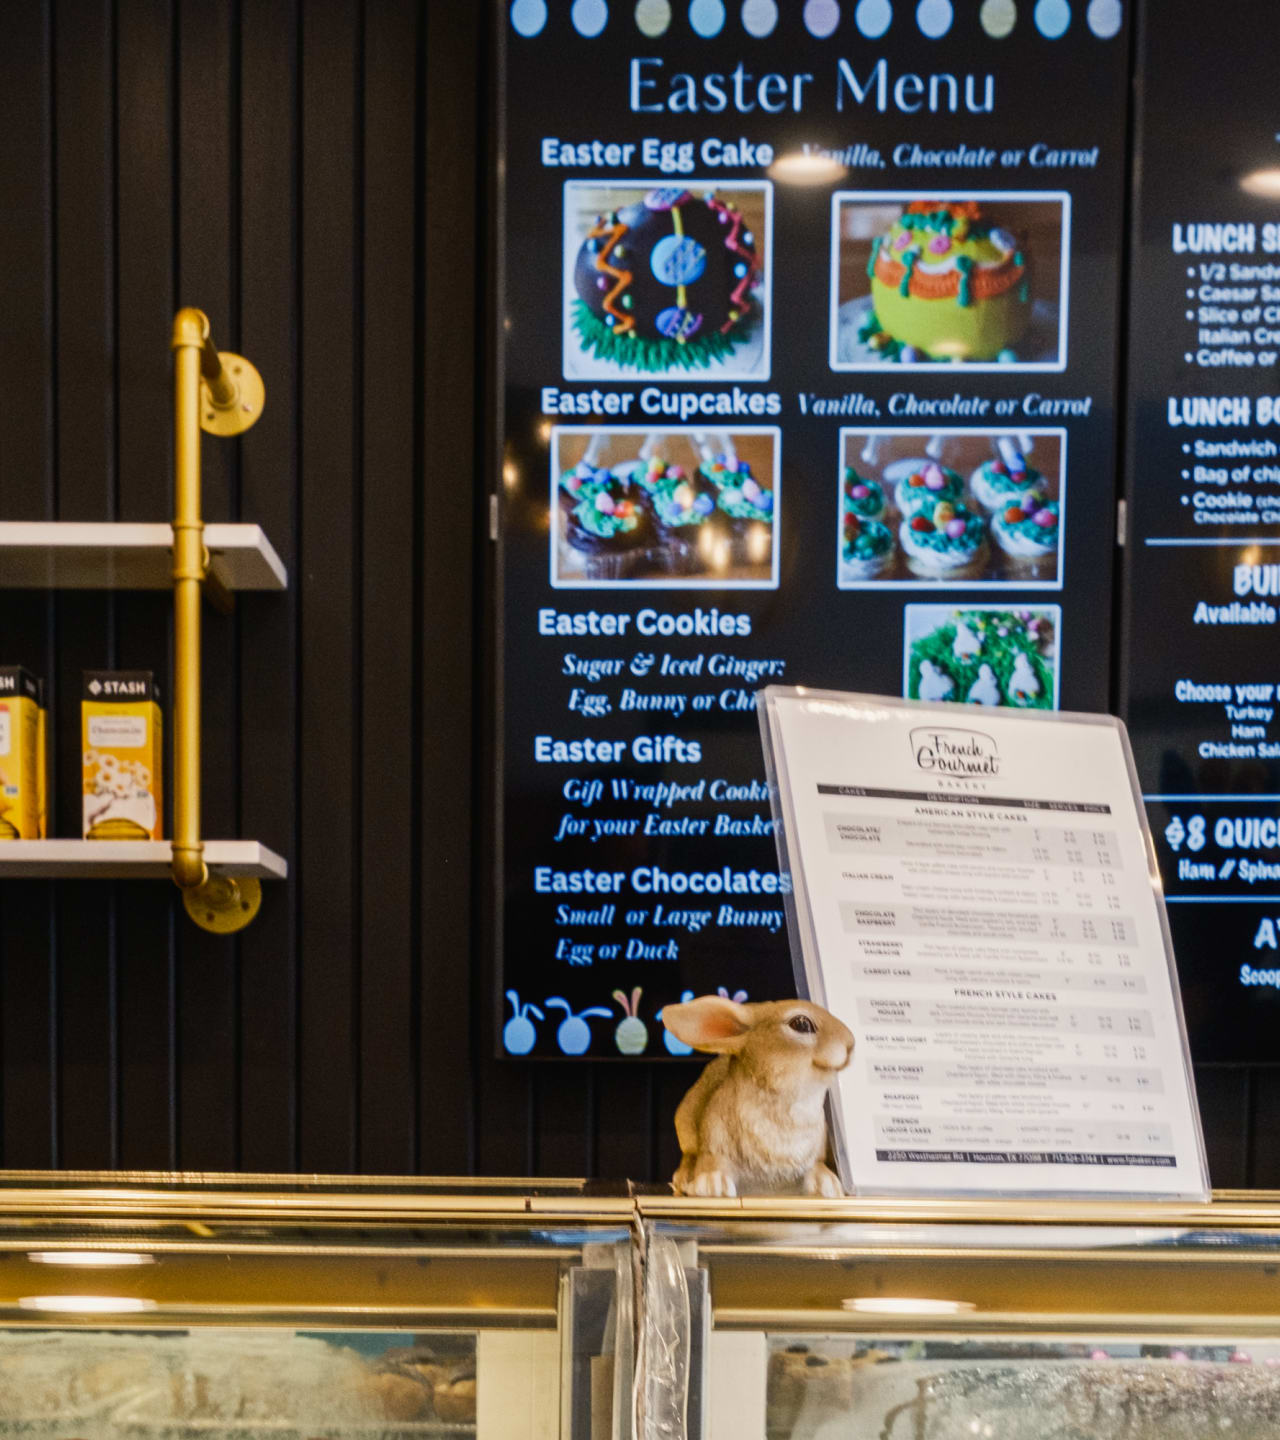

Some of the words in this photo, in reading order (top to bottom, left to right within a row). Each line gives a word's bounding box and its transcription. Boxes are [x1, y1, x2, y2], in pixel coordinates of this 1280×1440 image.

[629, 57, 814, 113] Easter
[836, 57, 995, 114] Menu
[541, 137, 636, 167] Easter
[641, 137, 696, 174] Egg
[700, 137, 777, 171] Cake
[1172, 222, 1257, 254] LUNCH
[541, 386, 635, 415] Easter
[639, 386, 782, 422] Cupcakes
[798, 392, 881, 418] Vanilla,
[887, 393, 991, 416] Chocolate
[994, 399, 1019, 416] or
[1021, 393, 1093, 417] Carrot
[1167, 396, 1252, 427] LUNCH
[538, 607, 632, 636] Easter
[635, 607, 752, 637] Cookies
[561, 653, 625, 683] Sugar
[629, 652, 656, 677] &
[659, 653, 705, 676] Iced
[103, 681, 146, 694] STASH
[534, 735, 627, 763] Easter
[631, 734, 702, 764] Gifts
[917, 746, 999, 775] Gourmet
[931, 734, 982, 756] French
[1164, 814, 1207, 852] $8
[533, 865, 627, 894] Easter
[630, 864, 795, 896] Chocolates
[555, 903, 617, 926] Small
[625, 909, 649, 926] or
[652, 903, 713, 933] Large
[716, 903, 789, 934] Bunny
[554, 937, 595, 966] Egg
[597, 943, 622, 960] or
[624, 938, 679, 961] Duck
